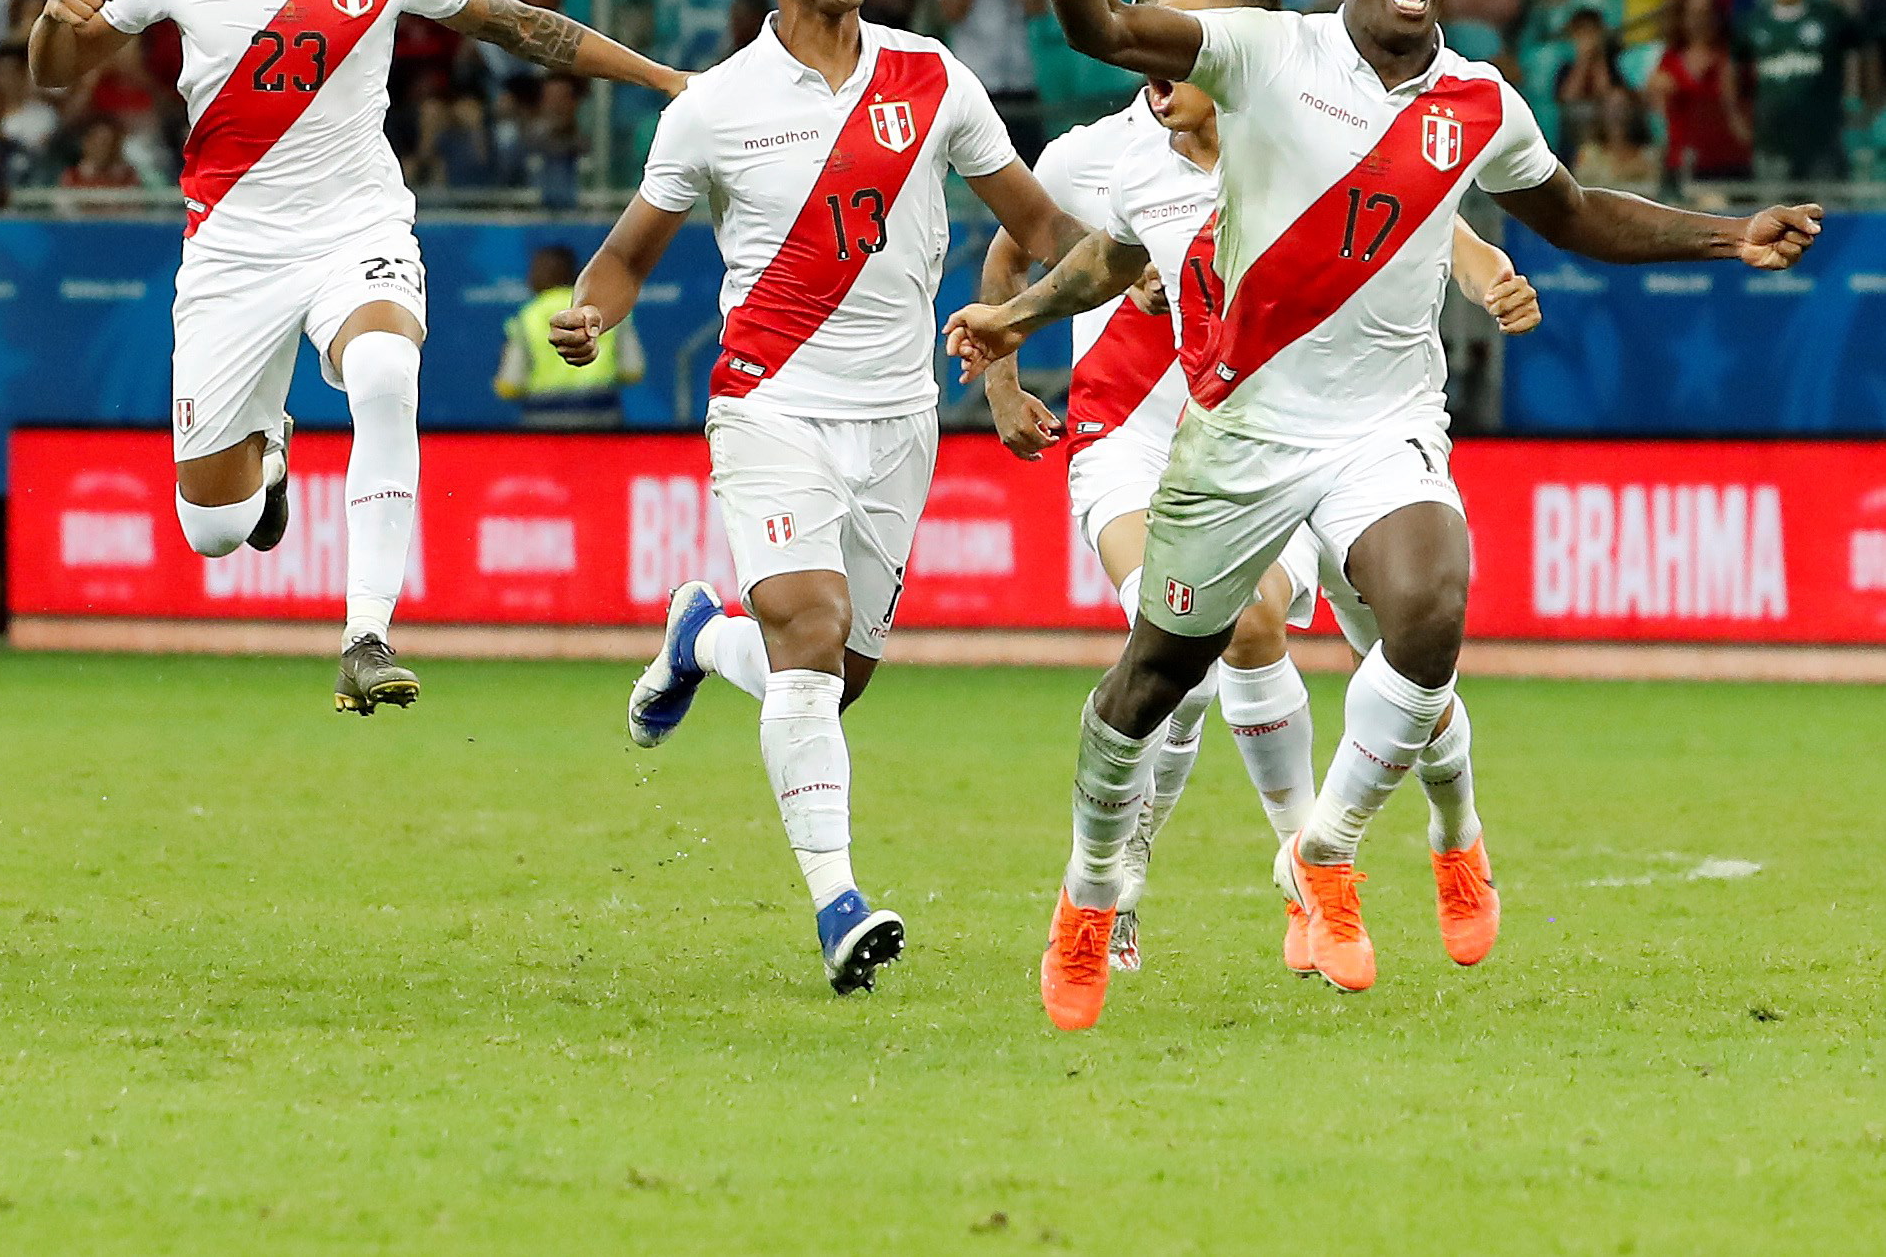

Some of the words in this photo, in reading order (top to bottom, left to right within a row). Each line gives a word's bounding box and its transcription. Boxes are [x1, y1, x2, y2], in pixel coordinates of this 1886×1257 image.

[251, 30, 328, 92] 23
[743, 128, 820, 150] marathon
[1298, 90, 1369, 131] marathon
[825, 187, 889, 261] 13
[1141, 202, 1199, 220] marathon
[1338, 187, 1403, 263] 17
[1188, 255, 1216, 312] 1
[1532, 482, 1788, 619] BRAHMA
